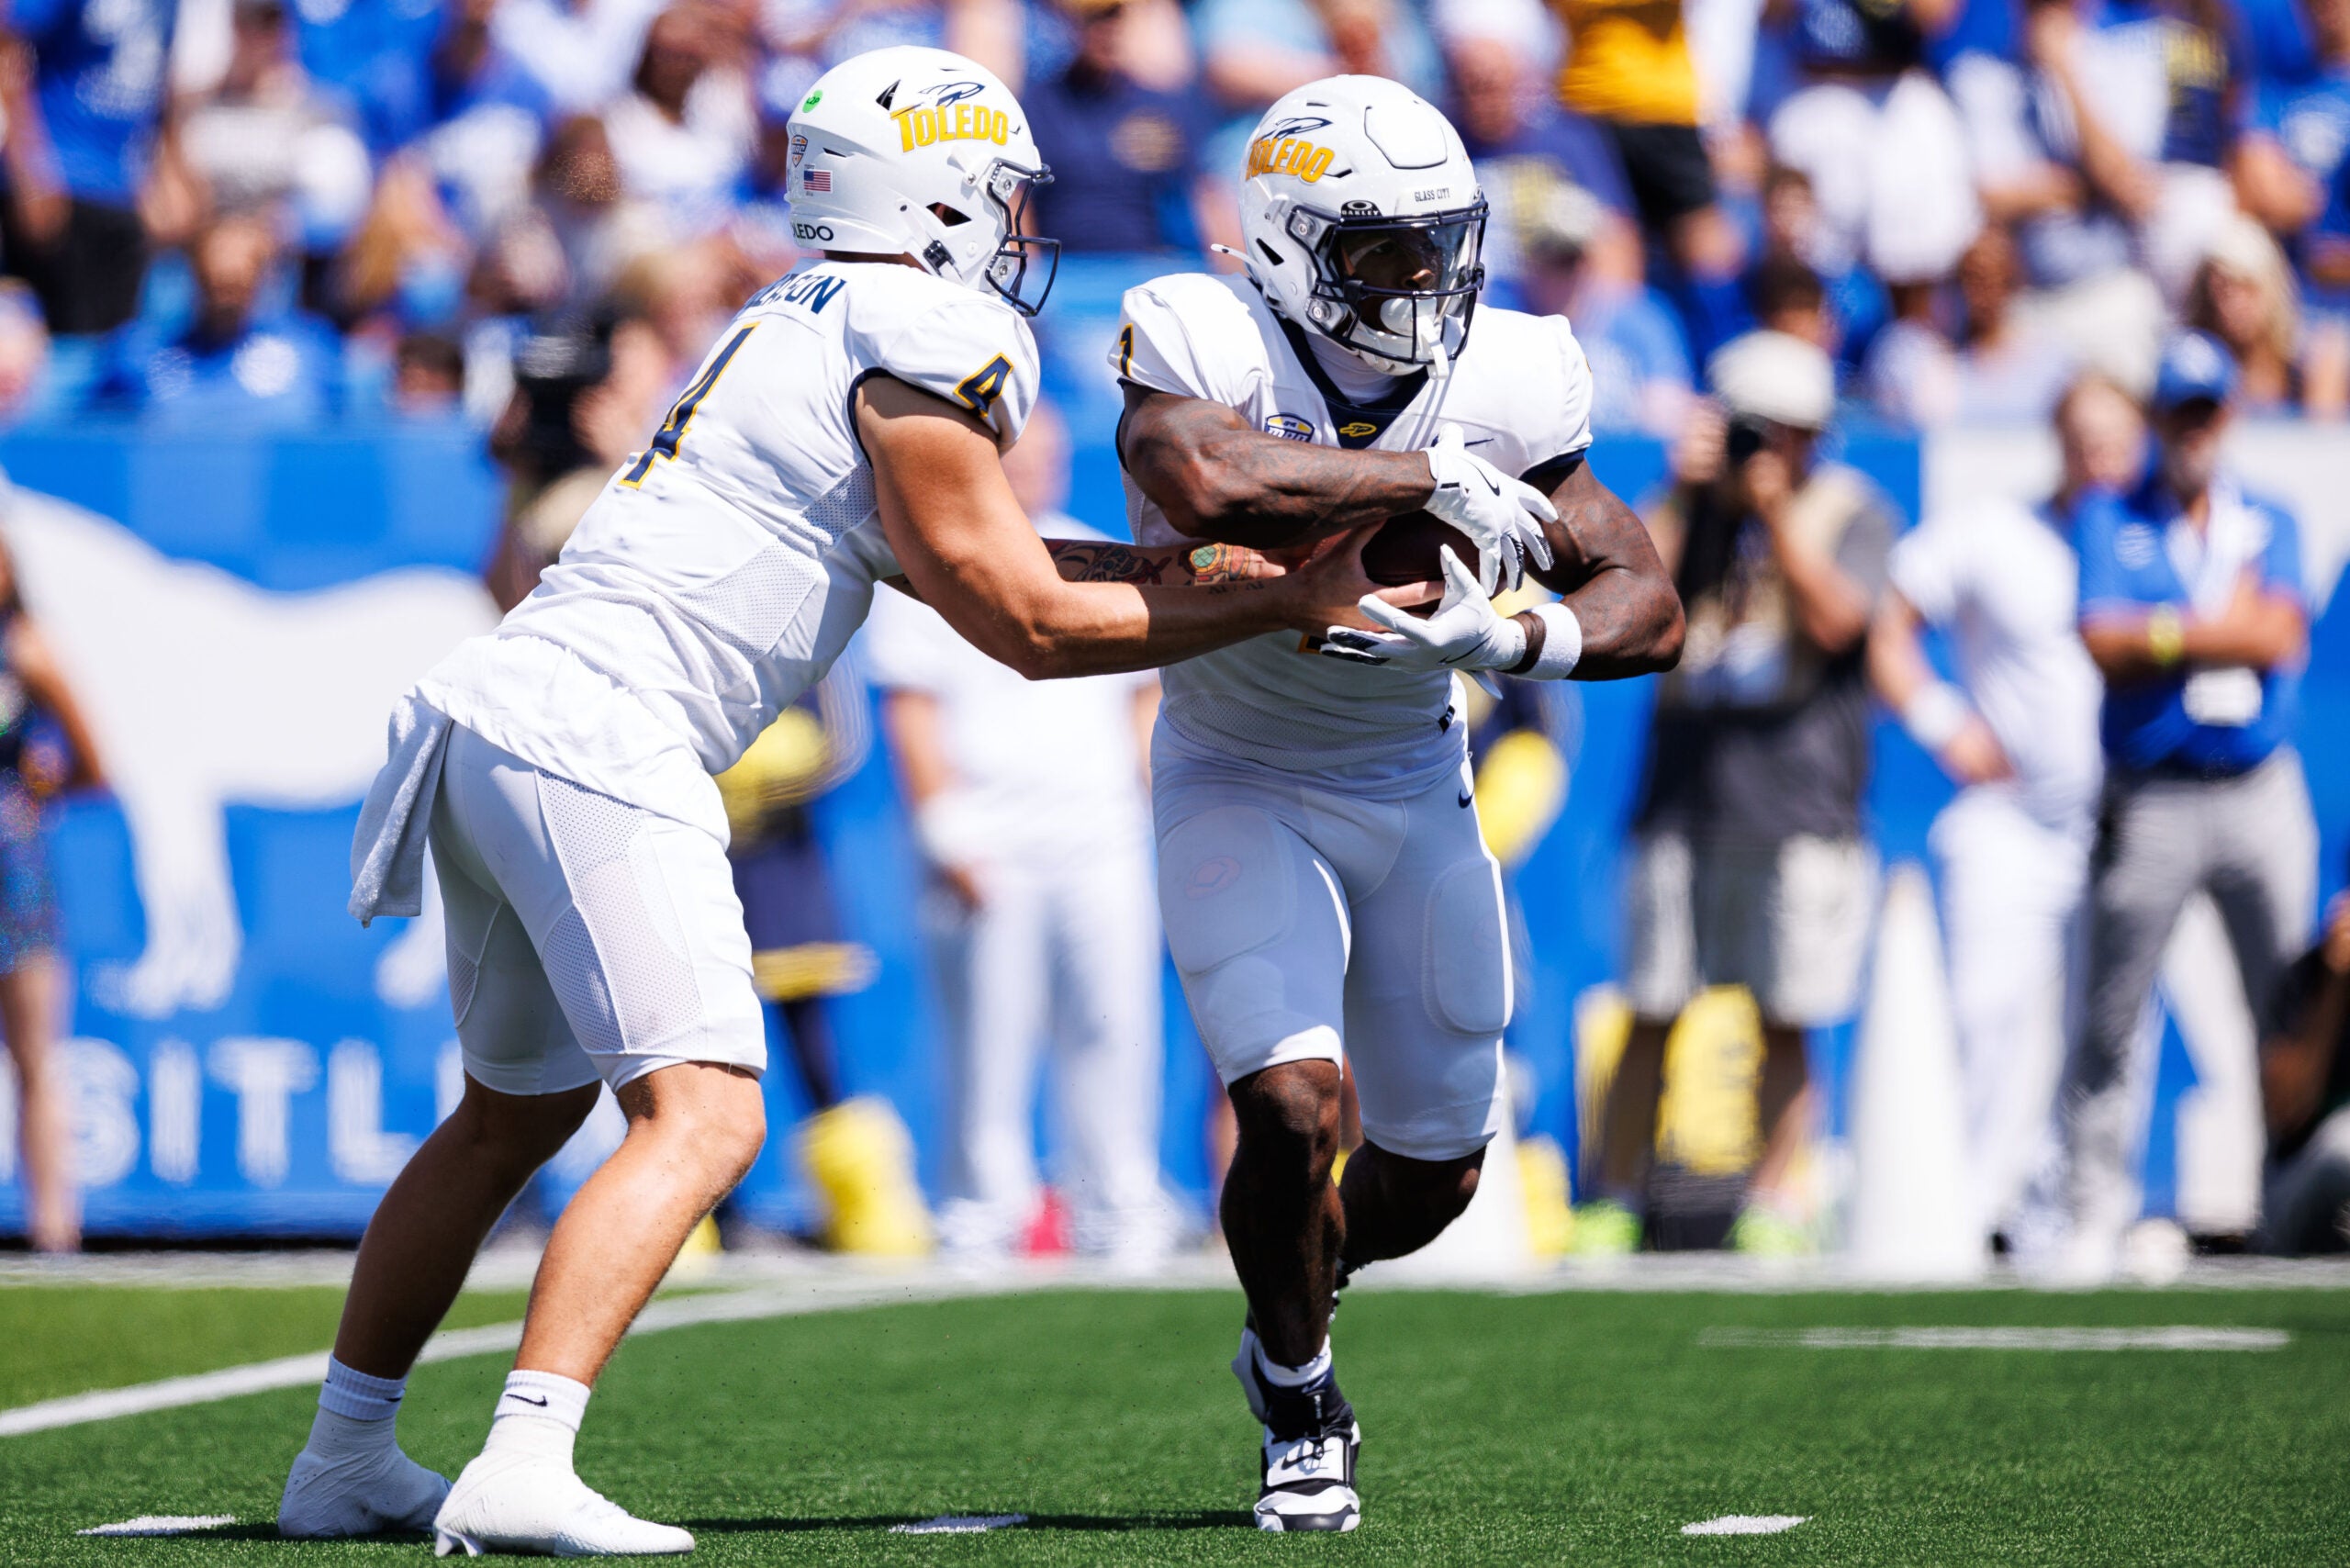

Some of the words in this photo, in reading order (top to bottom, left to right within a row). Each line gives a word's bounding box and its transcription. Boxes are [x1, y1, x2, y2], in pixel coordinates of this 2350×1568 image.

[890, 104, 1009, 153] TOLEDO
[1415, 189, 1435, 202] GLASS
[1437, 187, 1450, 199] CITY
[792, 222, 834, 241] LEDO
[1118, 322, 1134, 378] 1
[619, 321, 760, 490] 4
[954, 353, 1014, 418] 4
